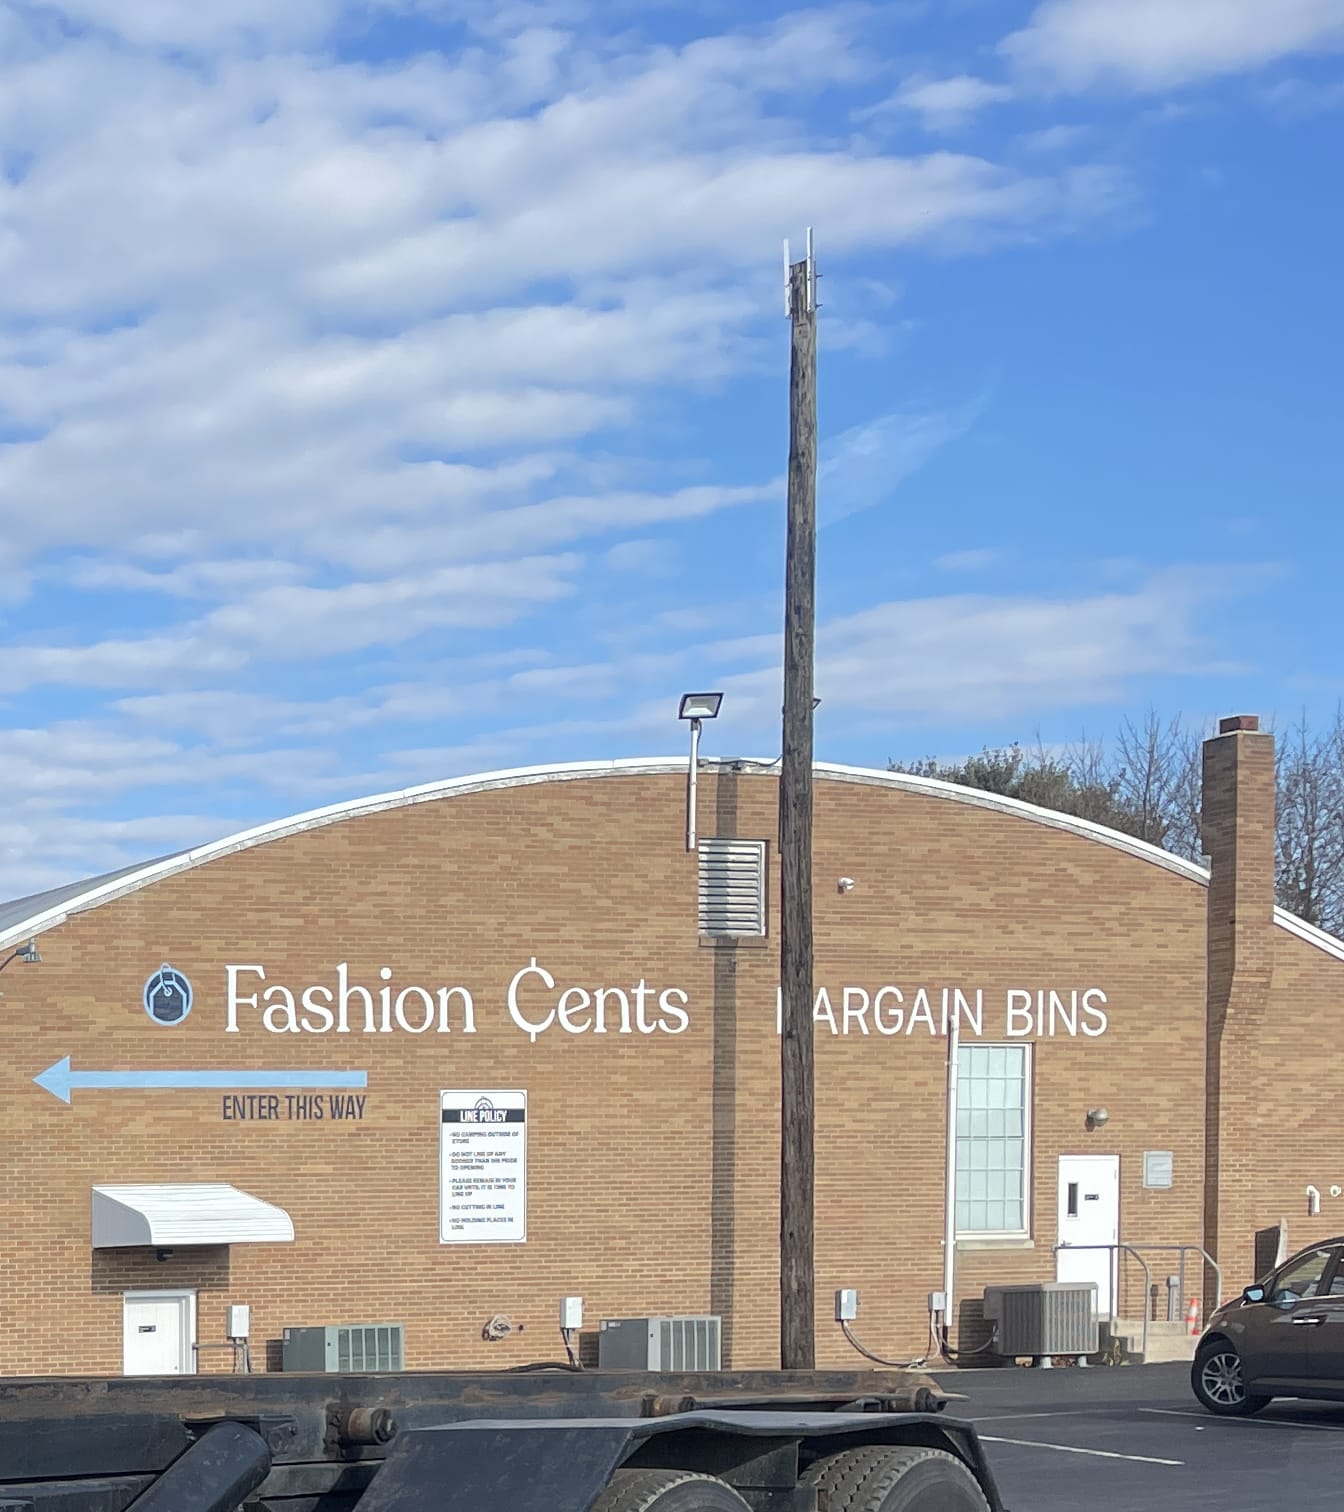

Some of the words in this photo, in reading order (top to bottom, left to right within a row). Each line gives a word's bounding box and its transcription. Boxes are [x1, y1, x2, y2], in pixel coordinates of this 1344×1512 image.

[224, 961, 478, 1034] Fashion
[776, 985, 983, 1036] ARGAIN
[1006, 988, 1108, 1037] BINS
[222, 1094, 280, 1121] ENTER
[284, 1094, 325, 1120] THIS
[328, 1093, 367, 1119] WAY
[459, 1110, 478, 1123] LINE
[479, 1109, 508, 1123] POLICY
